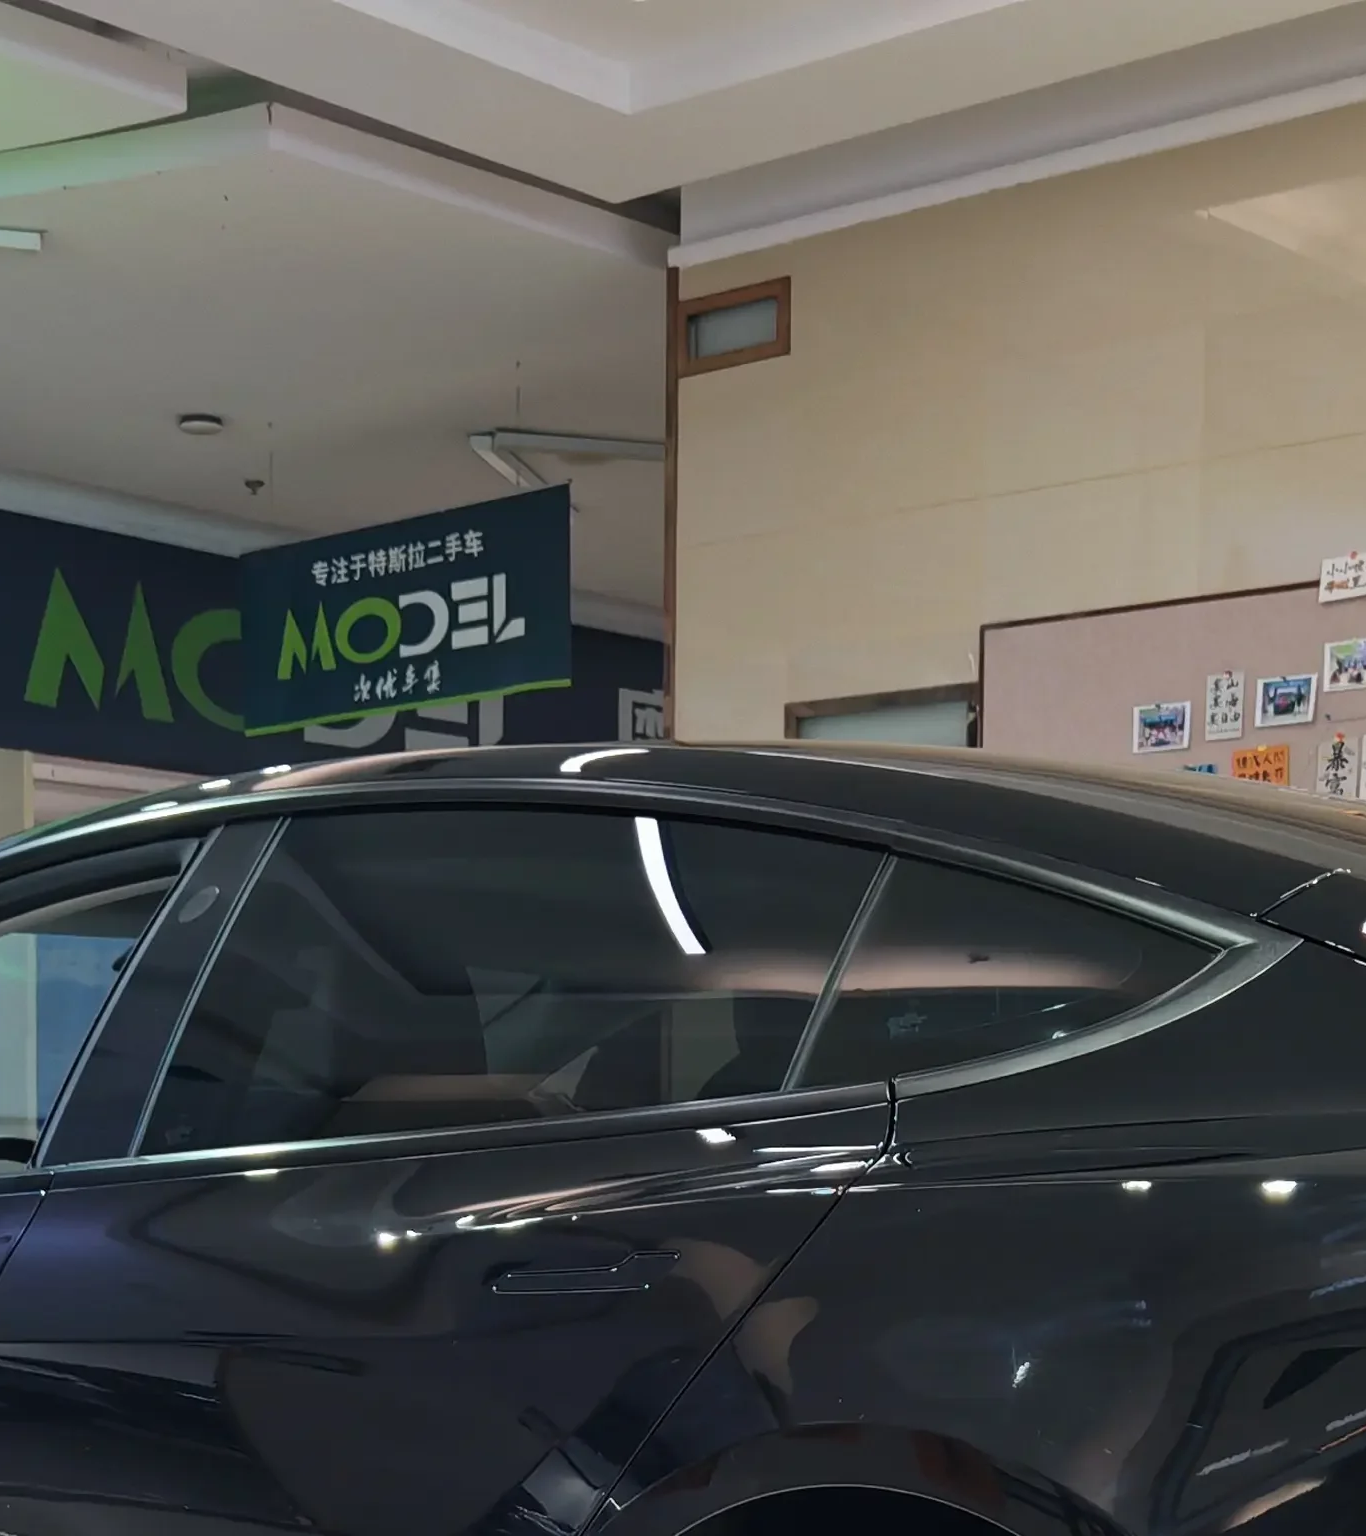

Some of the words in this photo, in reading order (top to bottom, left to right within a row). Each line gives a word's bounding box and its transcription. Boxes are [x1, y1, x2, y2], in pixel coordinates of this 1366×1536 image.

[311, 529, 485, 587] 专注于特斯拉二手车
[277, 572, 526, 681] MODEL
